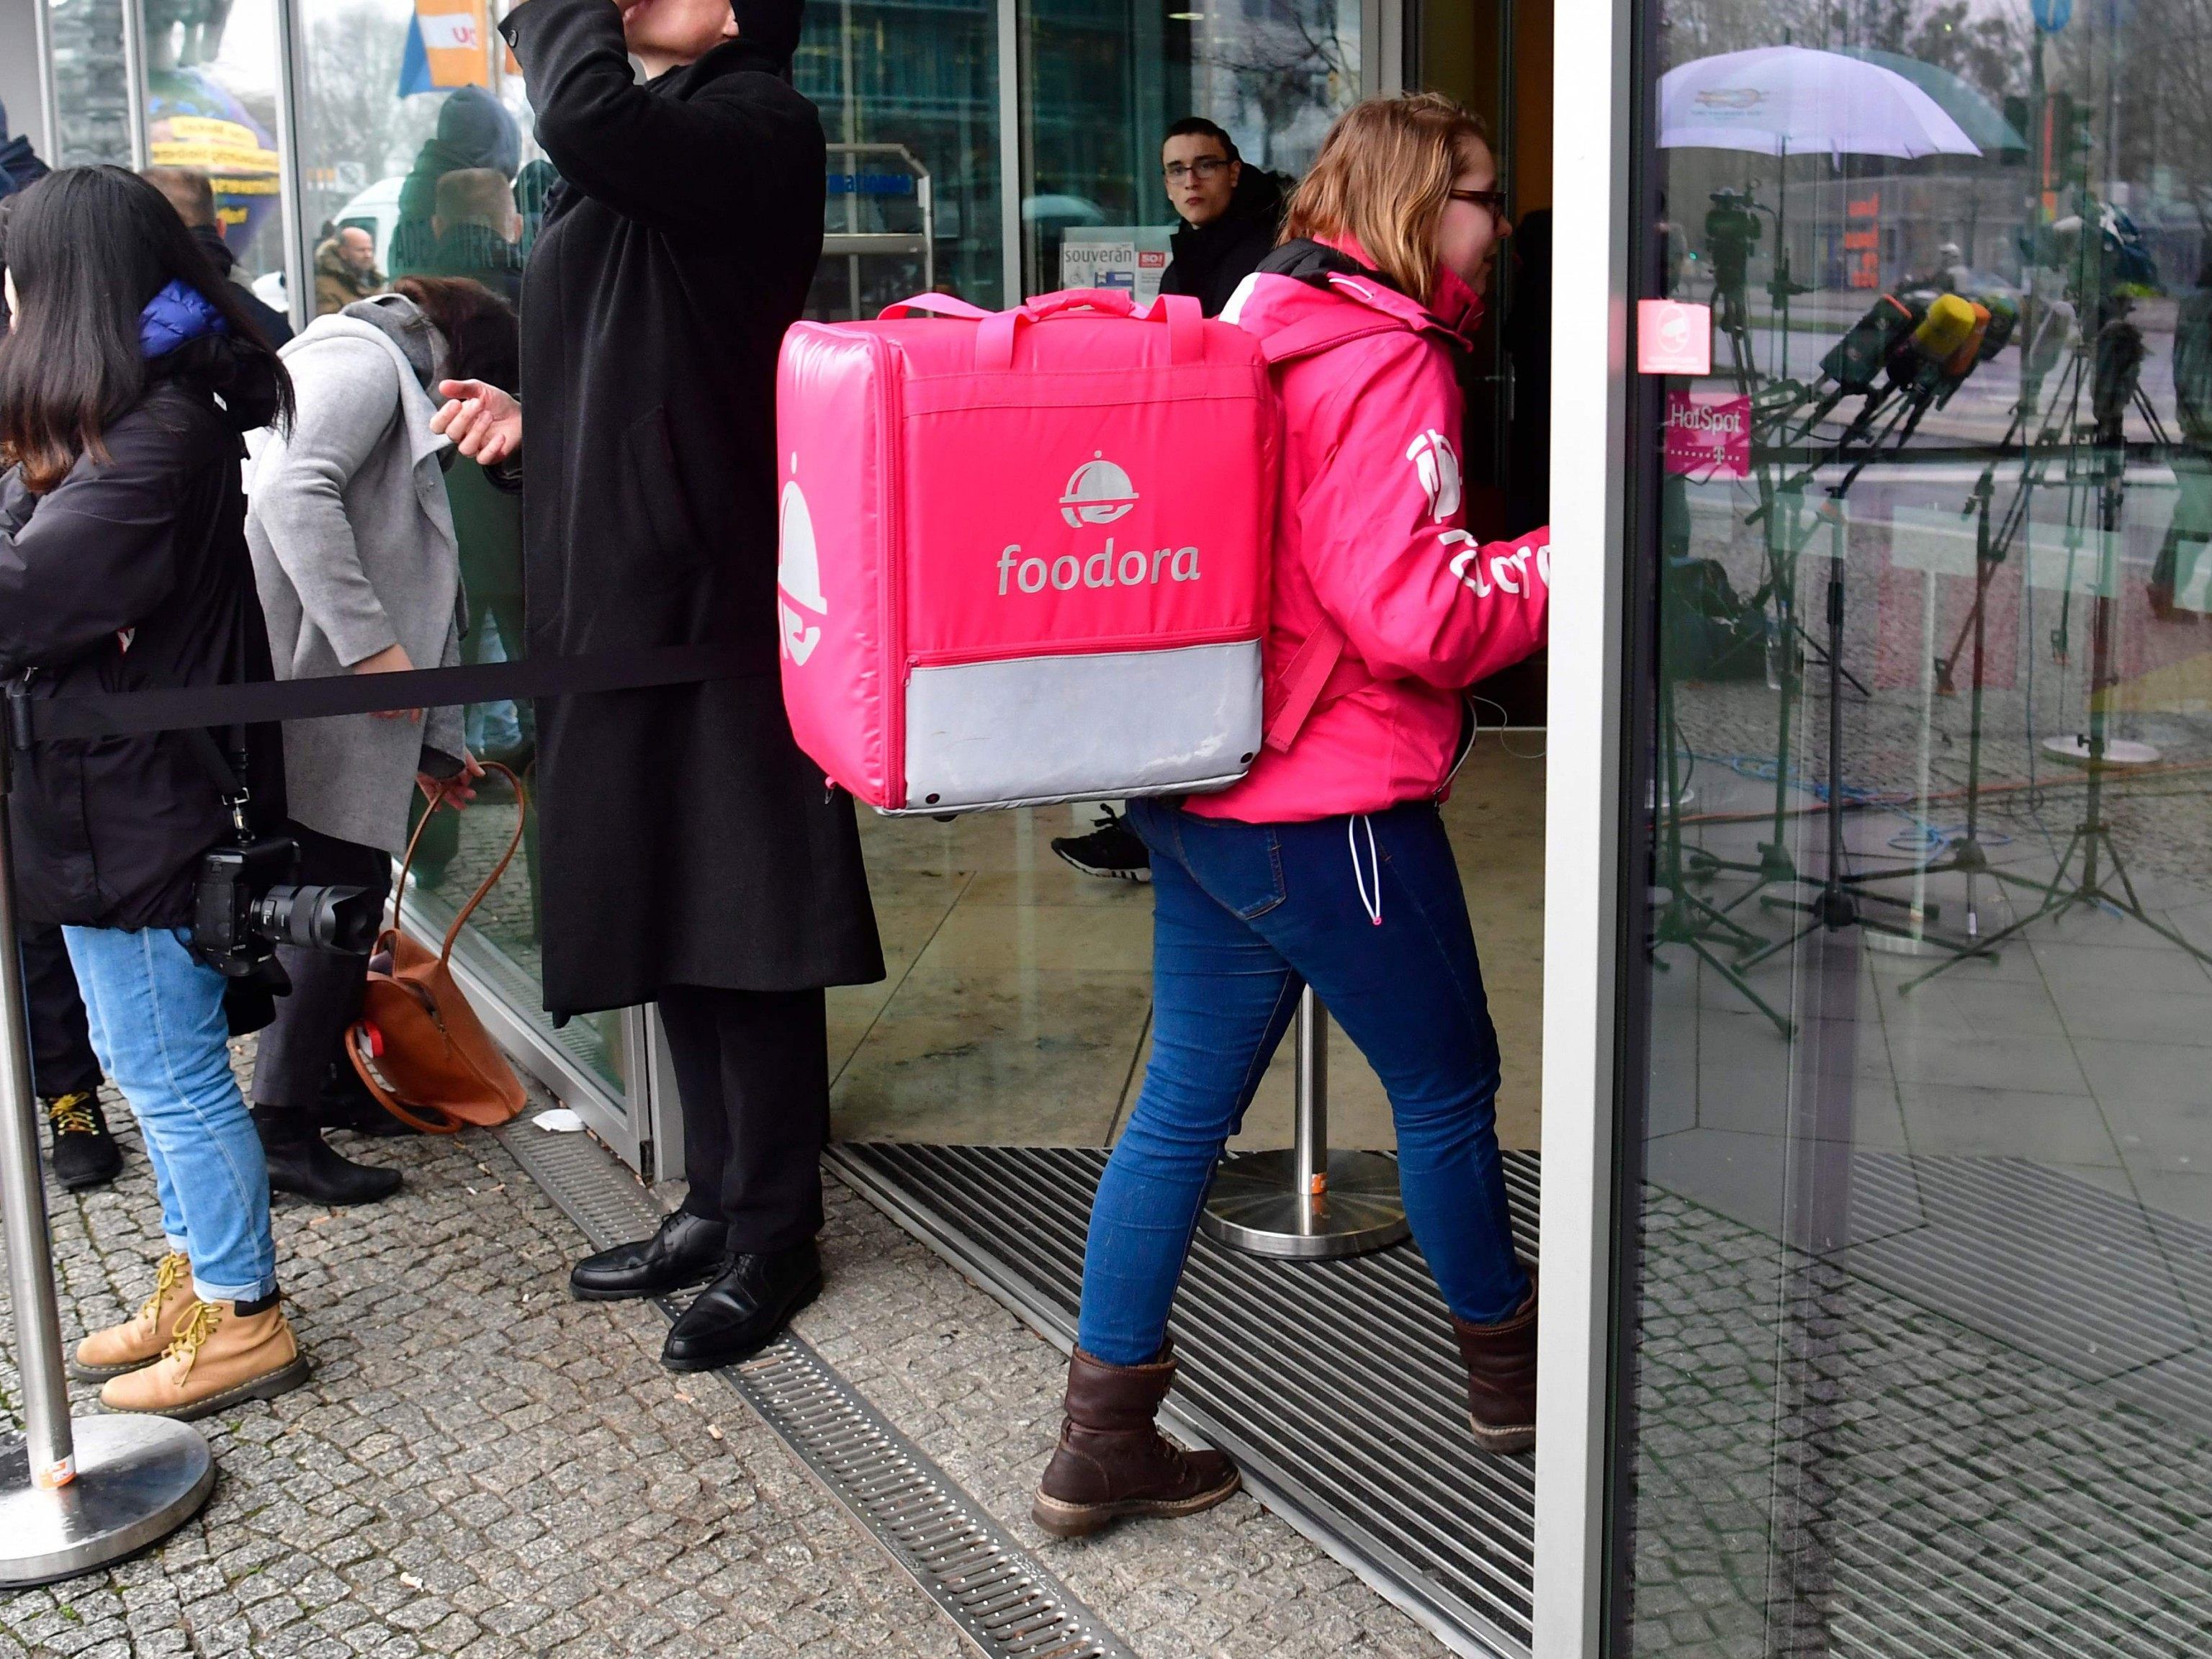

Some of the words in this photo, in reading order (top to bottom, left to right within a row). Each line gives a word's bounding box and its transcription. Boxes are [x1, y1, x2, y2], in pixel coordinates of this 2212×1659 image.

[1064, 247, 1132, 263] souverän
[1670, 403, 1741, 436] HotSpot
[996, 537, 1201, 596] foodora
